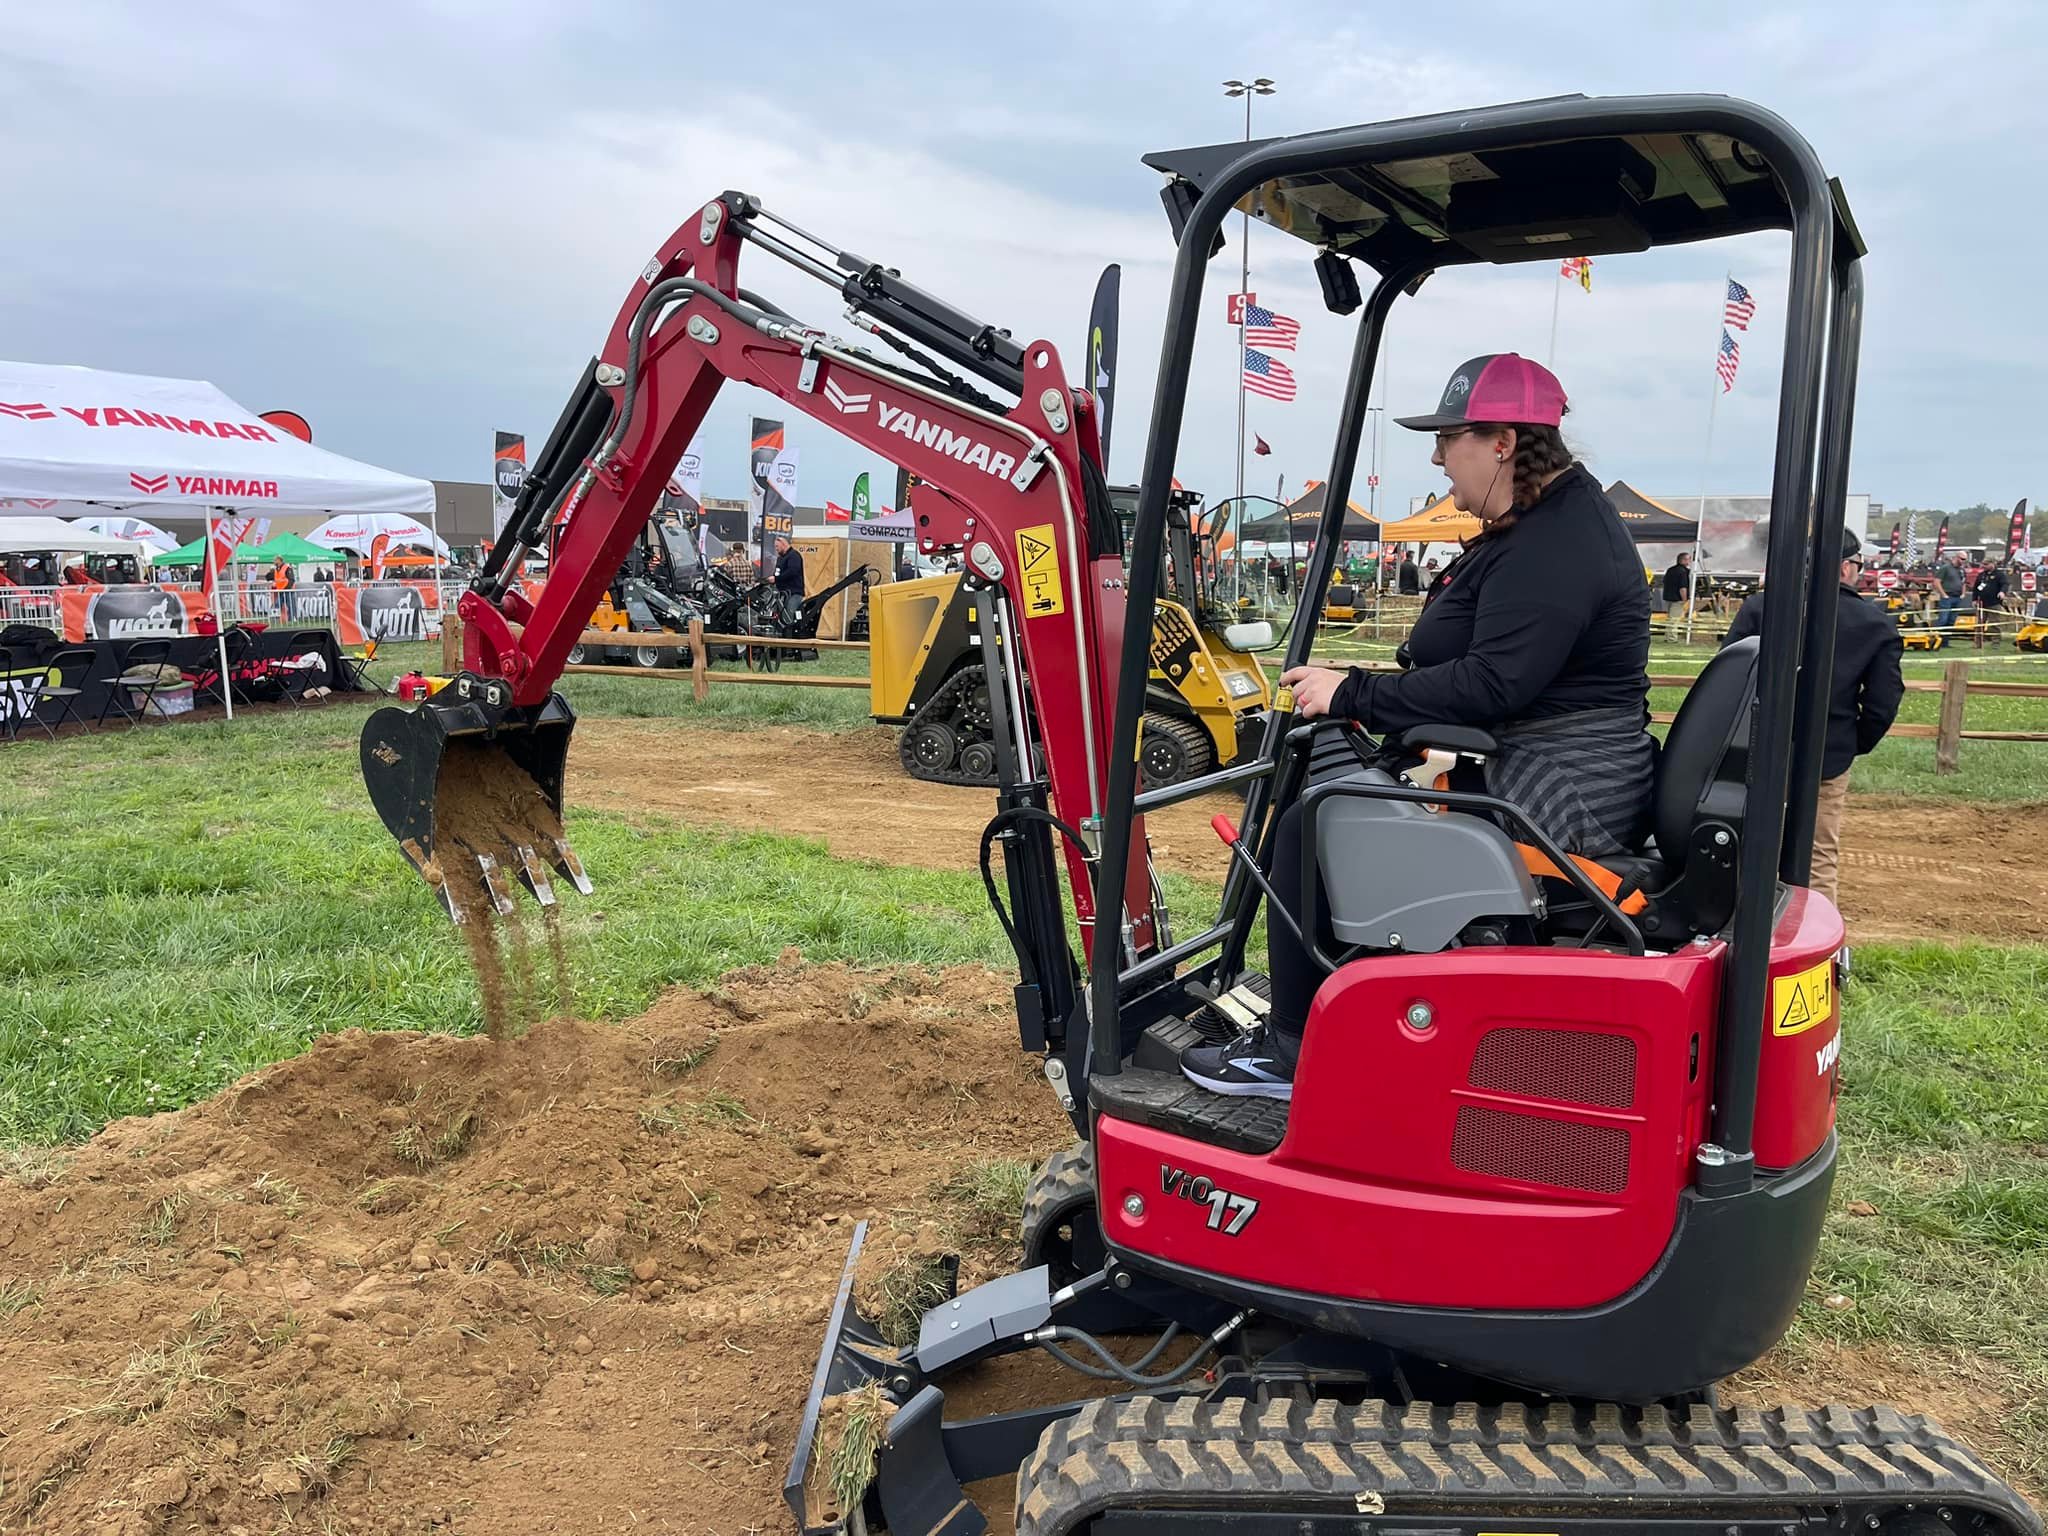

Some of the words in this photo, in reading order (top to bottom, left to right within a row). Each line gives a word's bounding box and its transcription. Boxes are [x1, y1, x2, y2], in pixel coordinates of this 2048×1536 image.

[60, 407, 279, 443] YANMAR
[877, 401, 1016, 481] YANMAR
[175, 476, 279, 498] YANMAR
[764, 515, 793, 532] BIG
[860, 526, 912, 538] COMPACT
[370, 607, 416, 637] KIOTI
